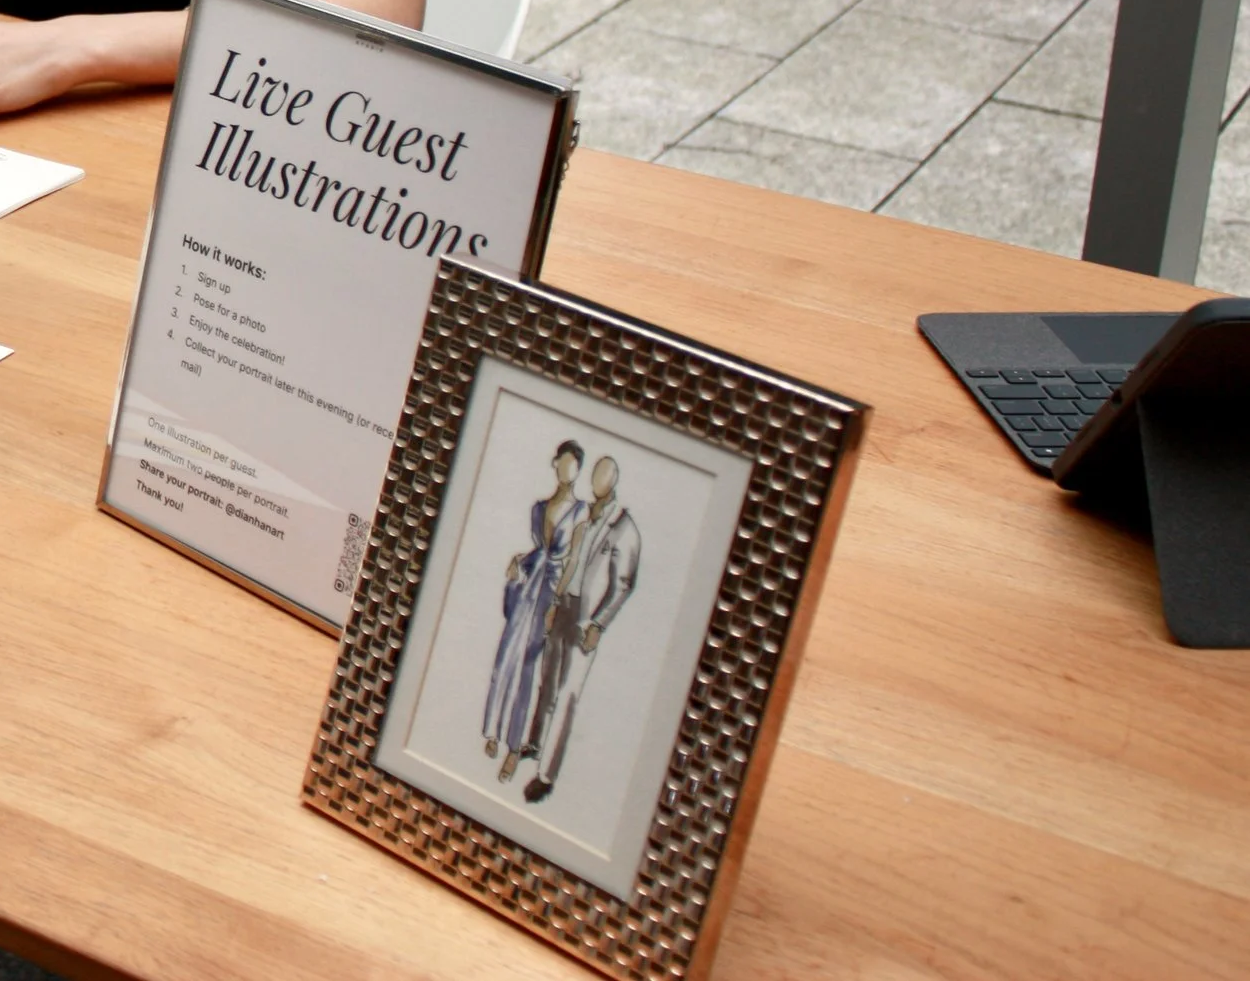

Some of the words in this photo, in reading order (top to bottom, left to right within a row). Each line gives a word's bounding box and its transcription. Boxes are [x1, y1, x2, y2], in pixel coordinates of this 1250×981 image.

[208, 49, 313, 125] Live
[325, 90, 470, 182] Guest
[181, 263, 188, 277] 1.
[197, 271, 217, 290] Sign
[219, 281, 231, 295] up
[182, 233, 210, 258] How
[212, 245, 222, 262] it
[224, 253, 267, 282] works:
[170, 307, 179, 319] 3.
[188, 315, 214, 336] Enjoy
[214, 325, 230, 341] the
[231, 334, 286, 366] celebration!
[175, 285, 183, 298] 2.
[193, 293, 215, 312] Pose
[217, 302, 231, 317] for
[231, 311, 238, 322] a
[239, 313, 267, 334] photo
[166, 328, 175, 340] 4.
[185, 336, 216, 360] Collect
[217, 352, 239, 369] your
[238, 363, 273, 387] portrait
[274, 375, 296, 395] later
[297, 388, 315, 405] this
[316, 397, 355, 424] evening
[356, 413, 371, 428] (or
[180, 359, 202, 377] mail)
[147, 416, 166, 435] One
[166, 425, 212, 455] illustration
[212, 450, 229, 464] per
[230, 459, 258, 479] guest.
[136, 479, 162, 502] Thank
[163, 494, 185, 513] you!
[139, 459, 165, 480] Share
[166, 473, 187, 492] your
[187, 482, 224, 510] portrait:
[225, 502, 285, 541] @dianhanart
[144, 437, 185, 466] Maximum
[186, 460, 203, 476] two
[203, 470, 236, 493] people
[236, 486, 253, 500] per
[254, 495, 289, 520] portrait.
